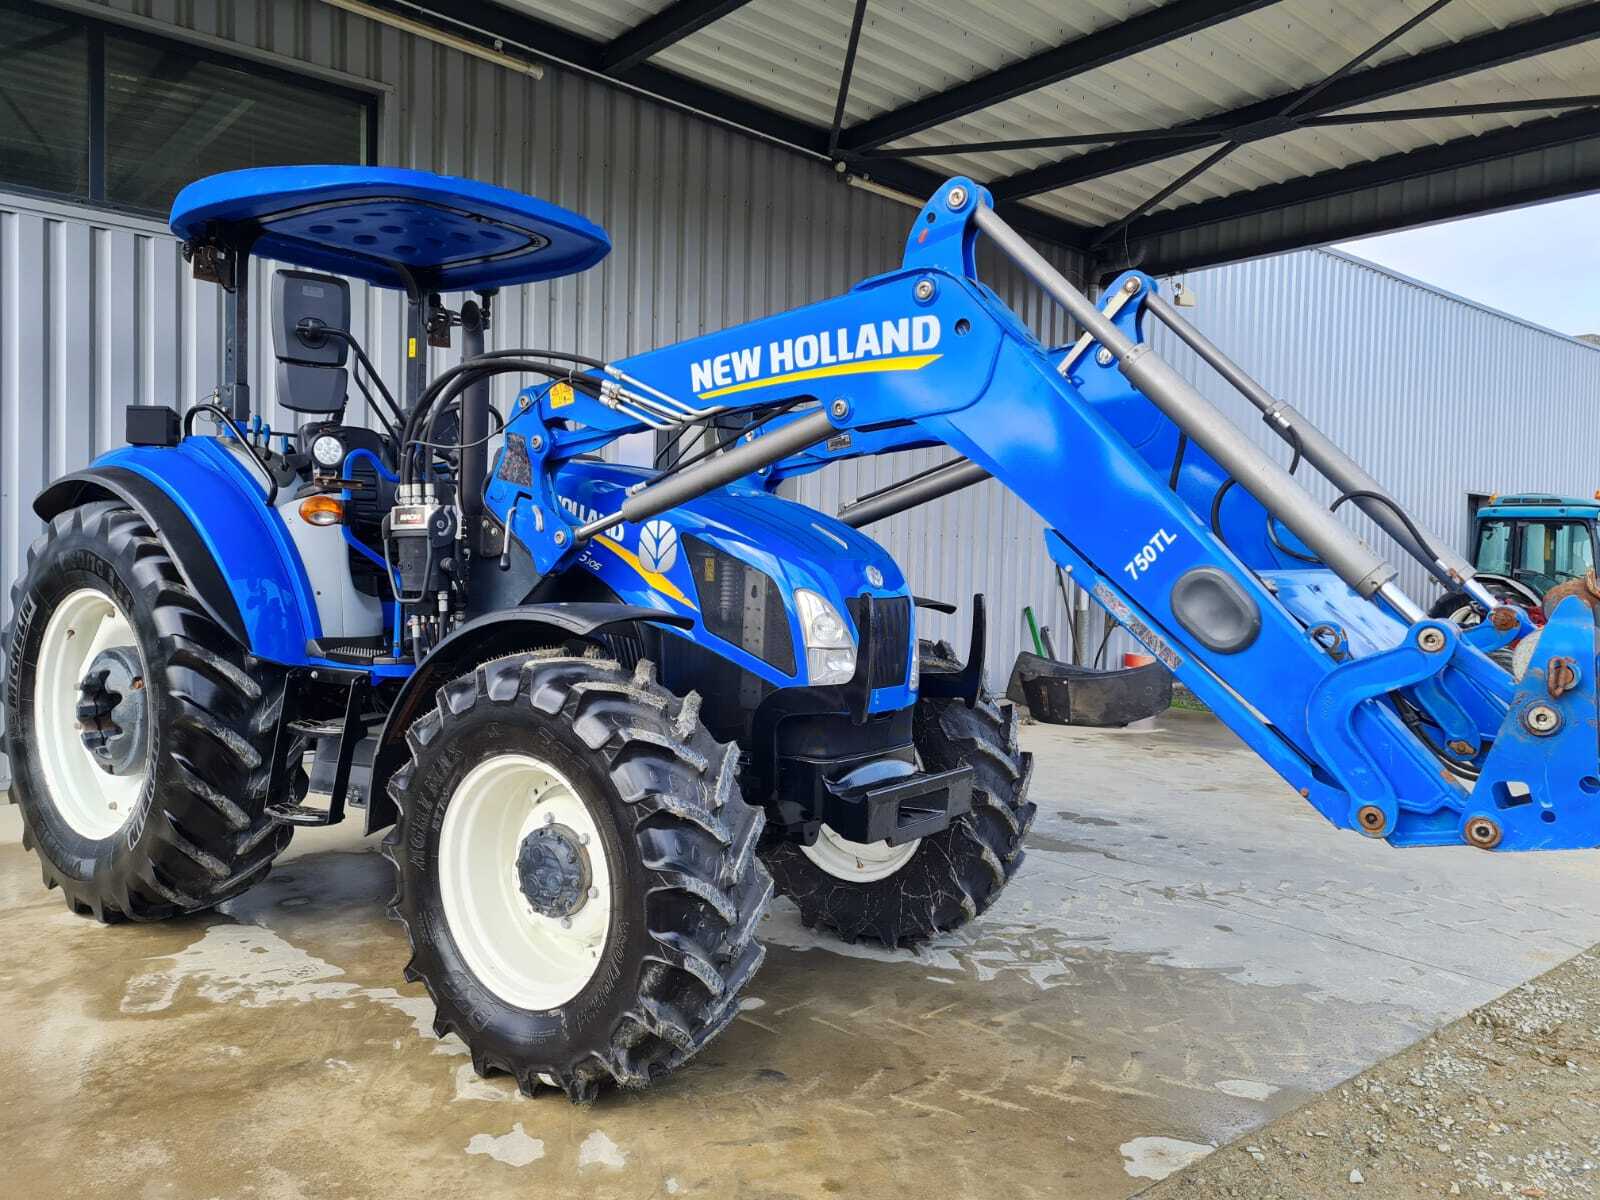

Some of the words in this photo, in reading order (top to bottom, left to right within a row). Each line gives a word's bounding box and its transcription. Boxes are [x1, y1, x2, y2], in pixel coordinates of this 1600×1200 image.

[690, 345, 761, 392] NEW
[769, 314, 941, 374] HOLLAND
[1124, 528, 1178, 581] 750TL
[7, 592, 37, 709] MICHELIN
